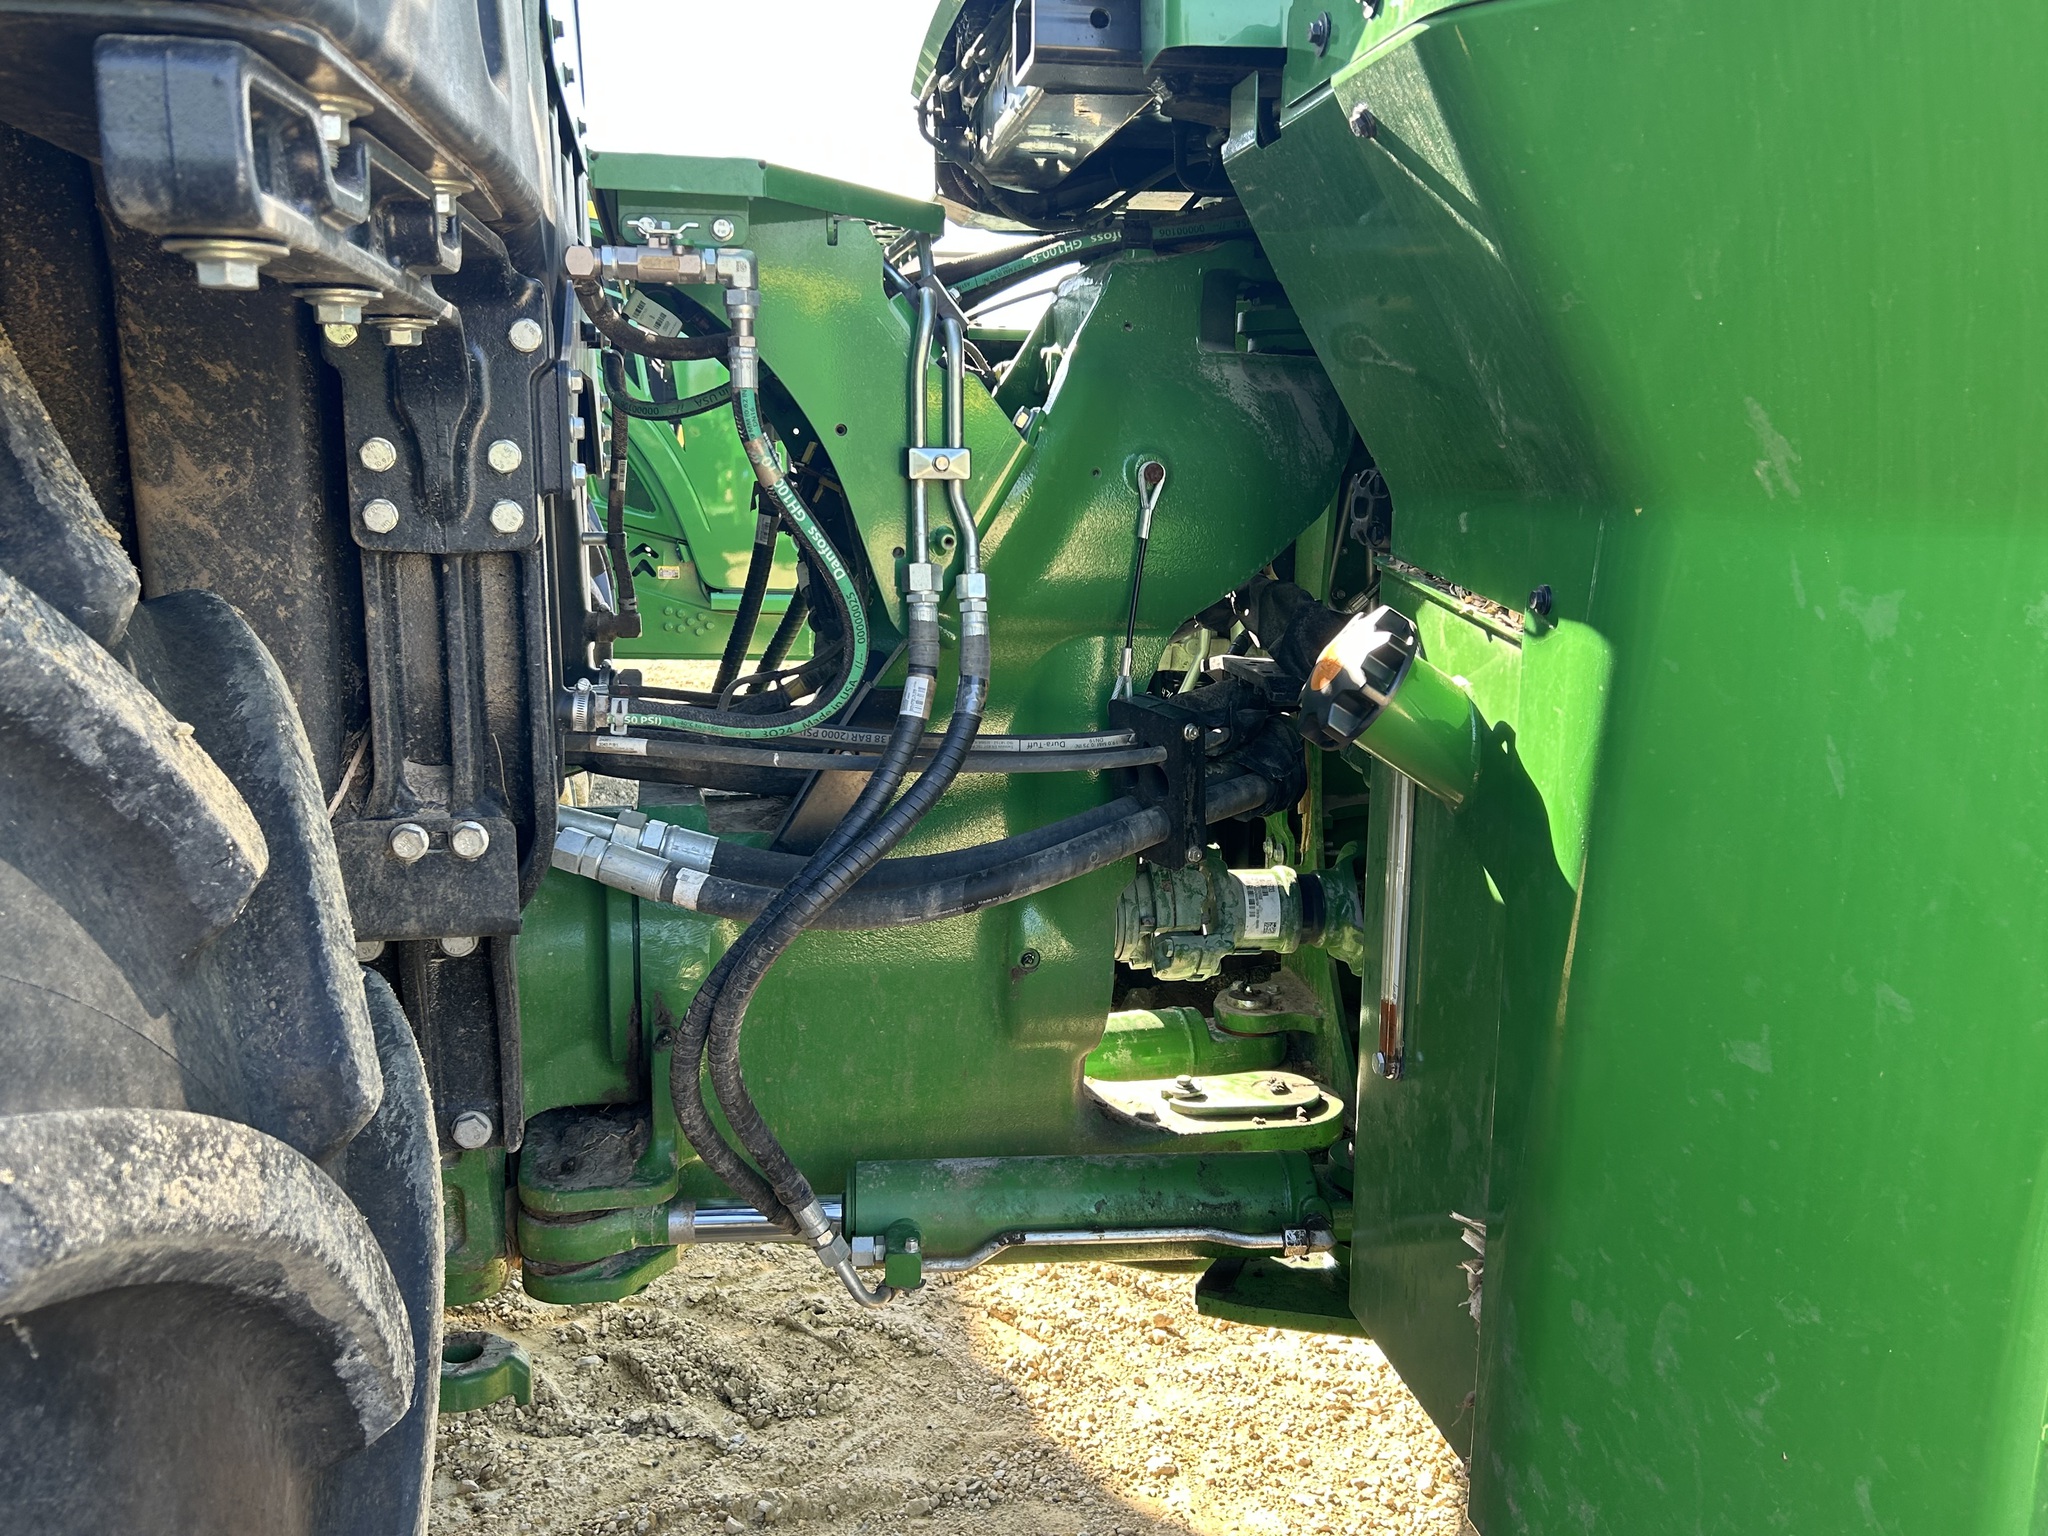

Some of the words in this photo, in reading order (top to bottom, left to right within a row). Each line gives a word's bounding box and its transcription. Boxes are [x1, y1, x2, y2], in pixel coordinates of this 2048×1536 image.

[1158, 224, 1205, 238] 00000106
[1030, 238, 1083, 264] GH100-8
[719, 387, 730, 398] in
[694, 394, 719, 408] USA
[807, 525, 847, 581] Danfoss
[845, 592, 866, 645] 00000025
[840, 679, 858, 700] USA
[830, 700, 843, 711] in
[640, 716, 662, 726] PSI)
[801, 711, 833, 730] Made
[820, 730, 851, 742] (2000
[850, 732, 873, 743] BAR
[1026, 740, 1066, 749] Dura-Tuff
